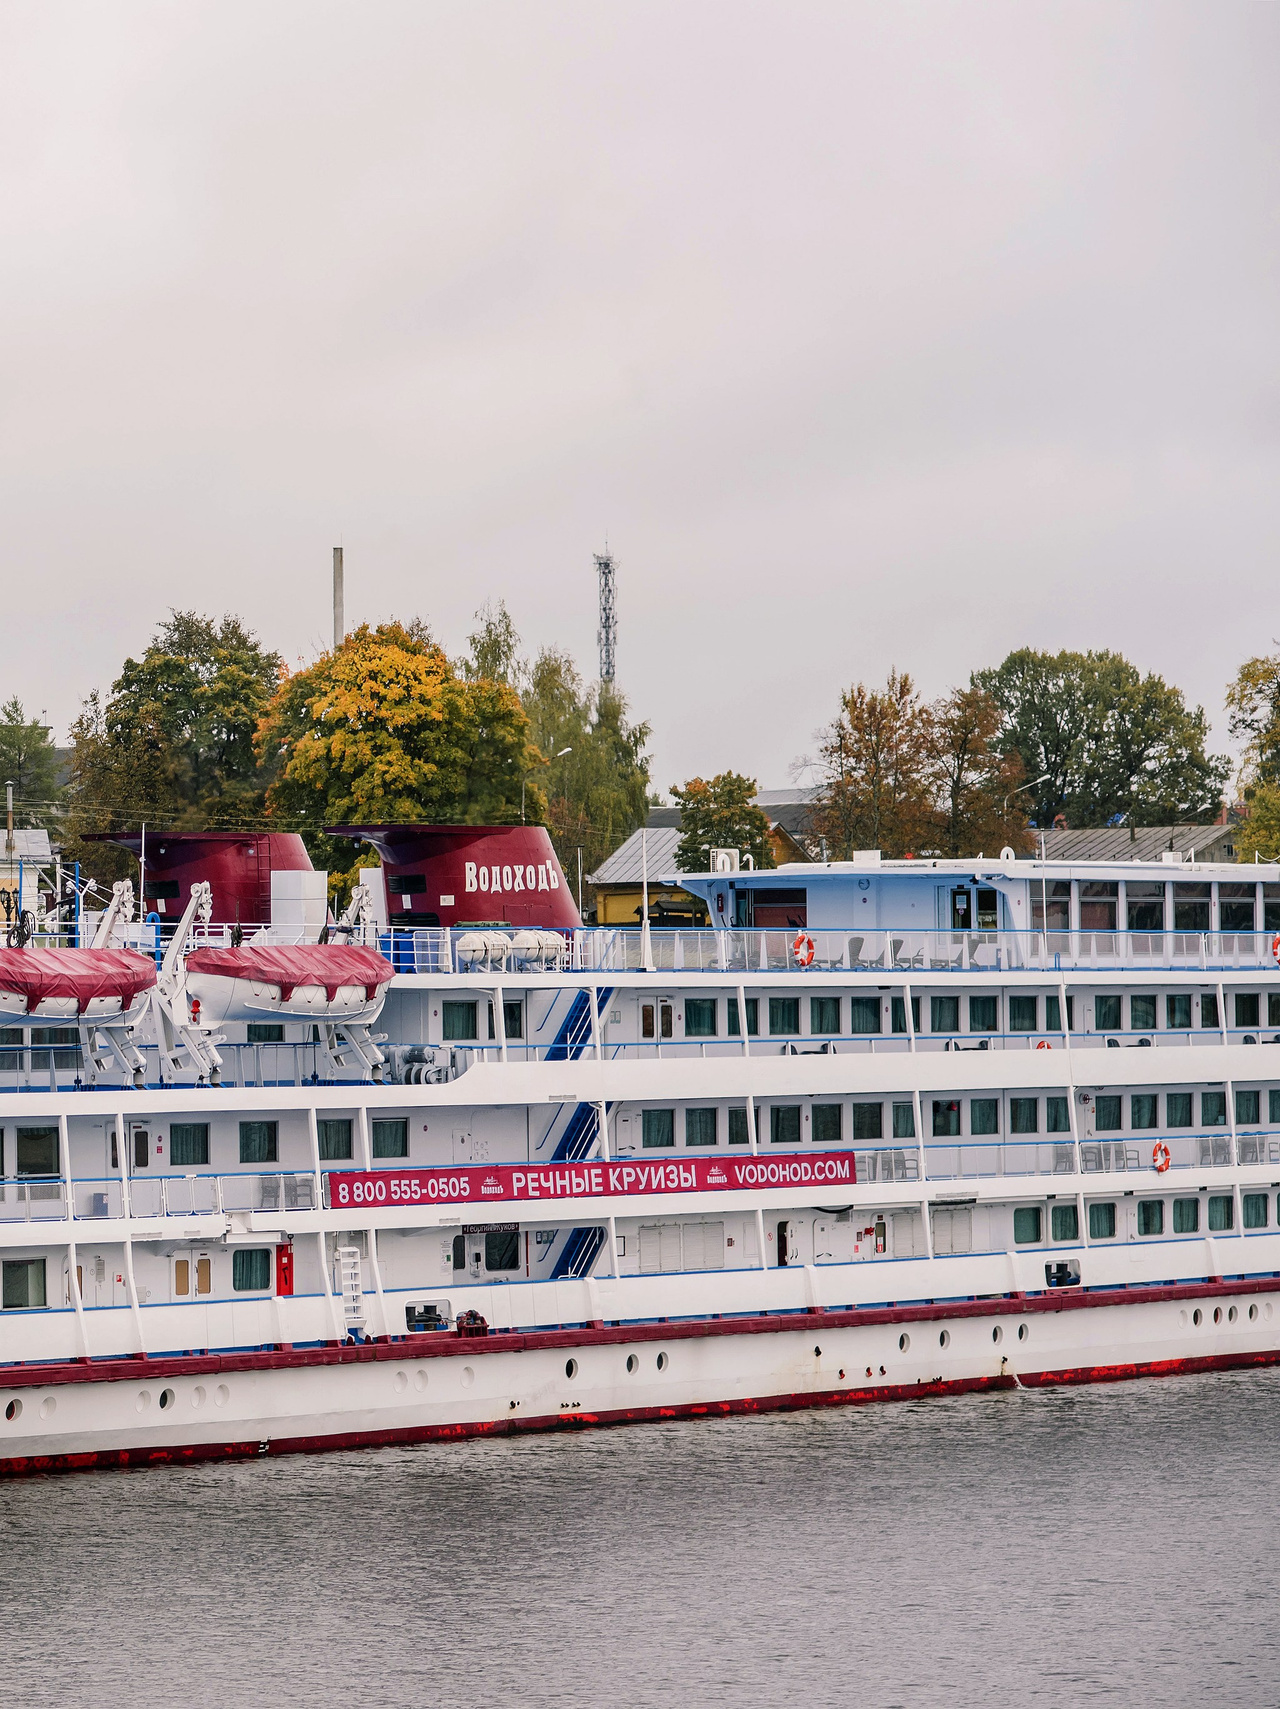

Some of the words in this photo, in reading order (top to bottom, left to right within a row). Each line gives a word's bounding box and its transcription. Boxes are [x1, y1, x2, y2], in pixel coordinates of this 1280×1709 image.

[465, 860, 559, 894] Водоходъ
[338, 1183, 350, 1204] 8
[353, 1181, 387, 1203] 800
[390, 1176, 470, 1200] 555-0505
[512, 1168, 604, 1197] РЕЧНЫЕ
[609, 1164, 697, 1191] КРУИЗЫ
[734, 1159, 850, 1184] VODOHOD.COM
